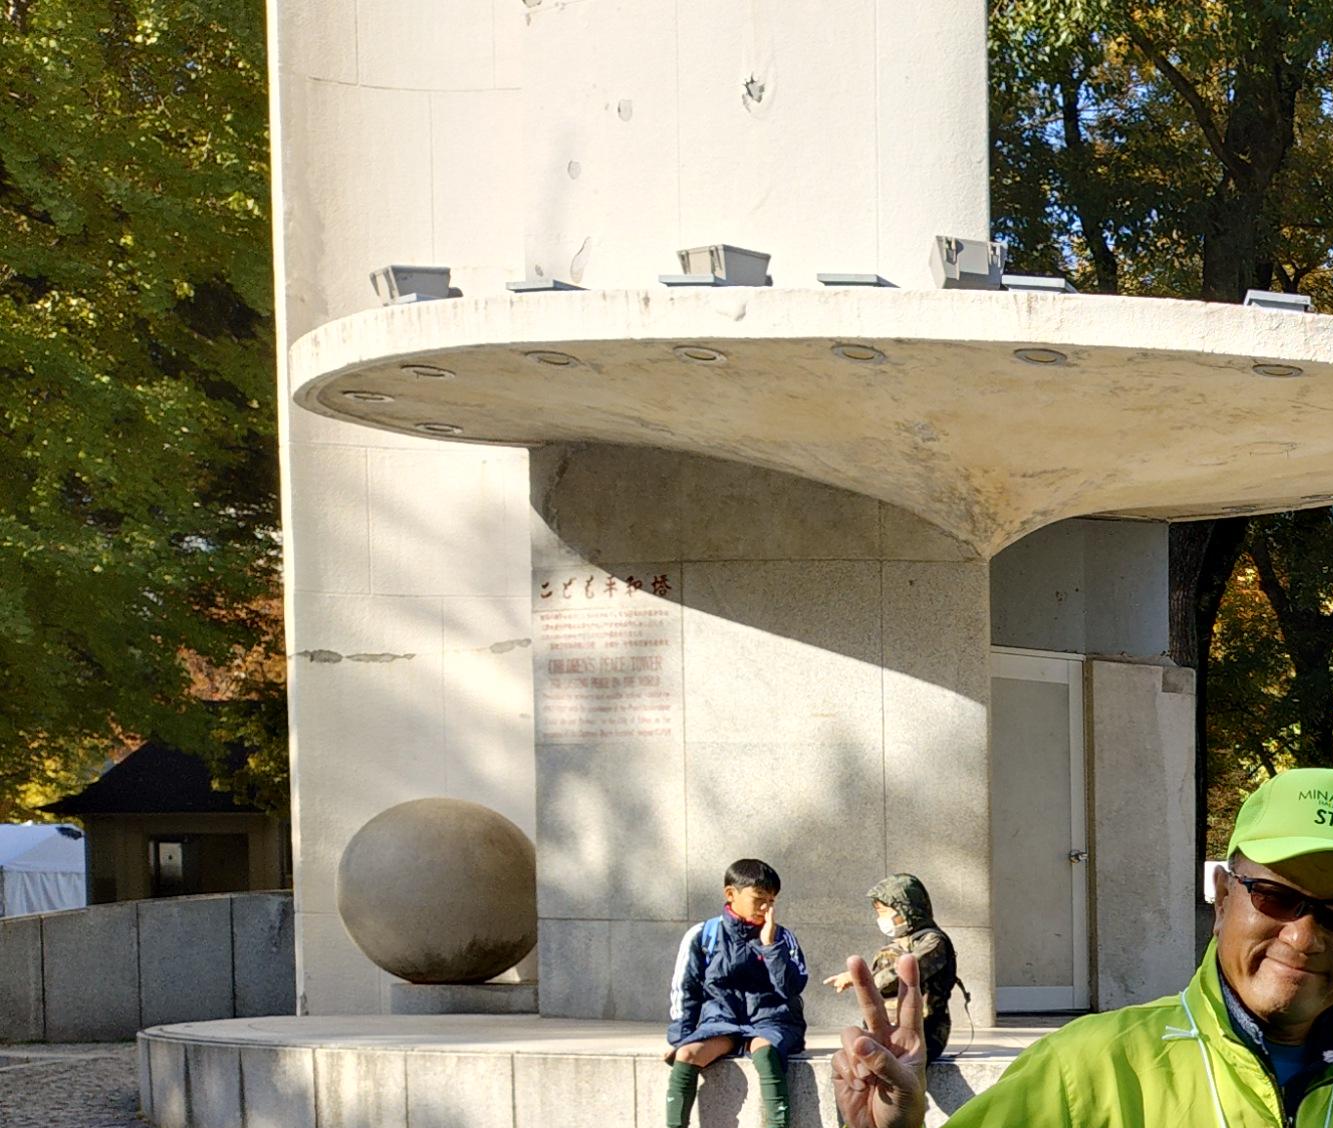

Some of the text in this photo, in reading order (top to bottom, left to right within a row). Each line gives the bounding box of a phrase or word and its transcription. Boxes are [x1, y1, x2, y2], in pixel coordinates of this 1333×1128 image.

[540, 574, 672, 599] こども平和塔
